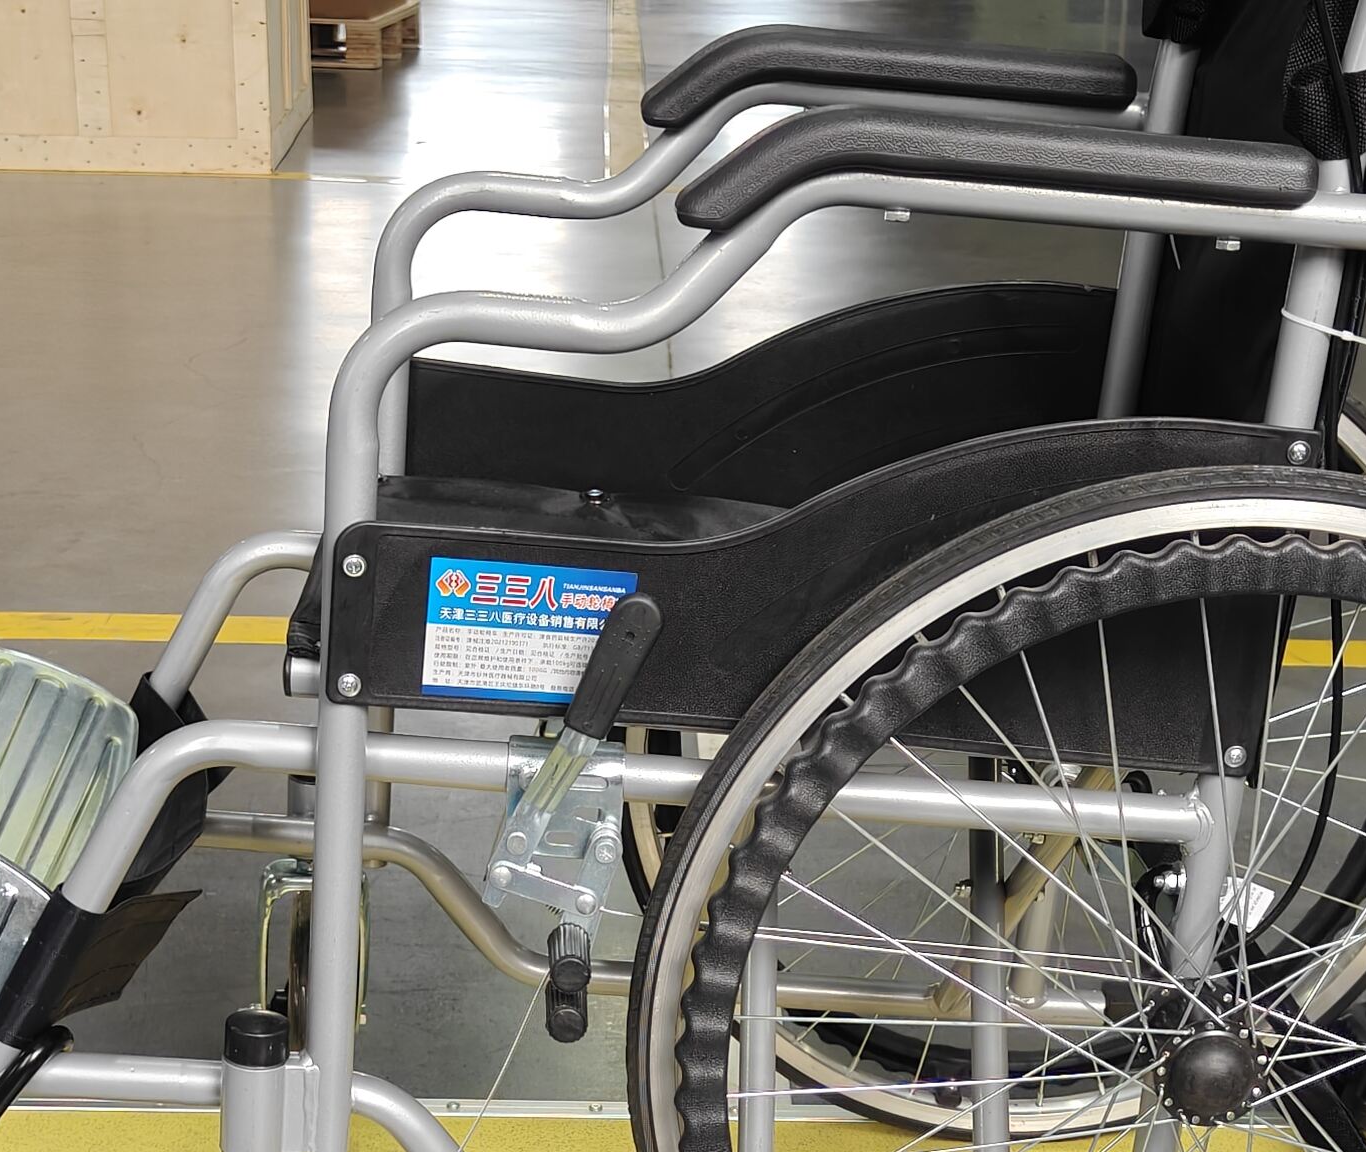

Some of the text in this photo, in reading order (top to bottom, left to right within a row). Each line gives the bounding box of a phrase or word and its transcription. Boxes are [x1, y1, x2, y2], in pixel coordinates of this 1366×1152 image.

[470, 572, 558, 611] 三三八
[560, 592, 619, 612] 手动轮椅
